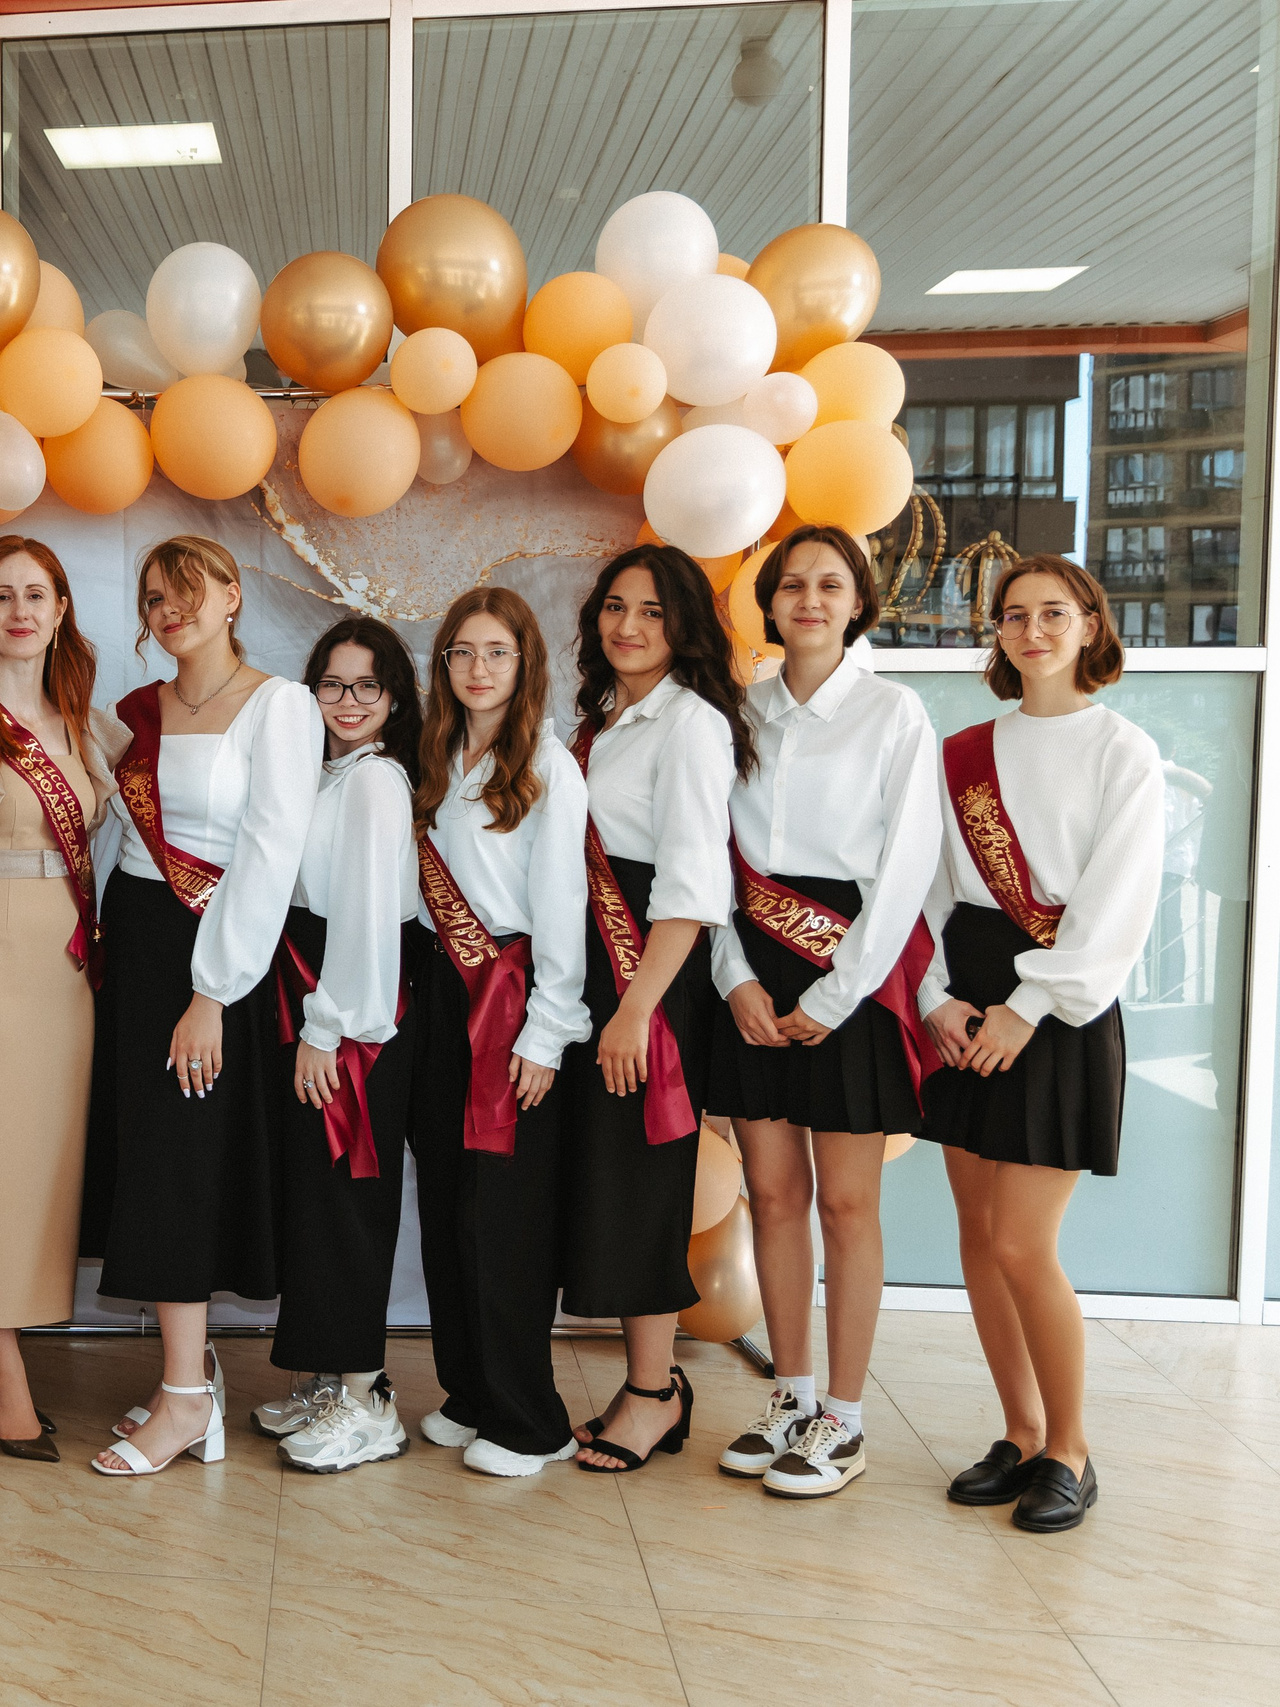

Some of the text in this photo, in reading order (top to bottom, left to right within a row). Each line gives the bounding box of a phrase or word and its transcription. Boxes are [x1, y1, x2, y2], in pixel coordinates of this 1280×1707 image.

[16, 753, 83, 870] ОВОДИТЕЛЬ
[22, 738, 83, 829] Классный
[434, 900, 500, 968] 2025
[762, 897, 848, 957] 2025
